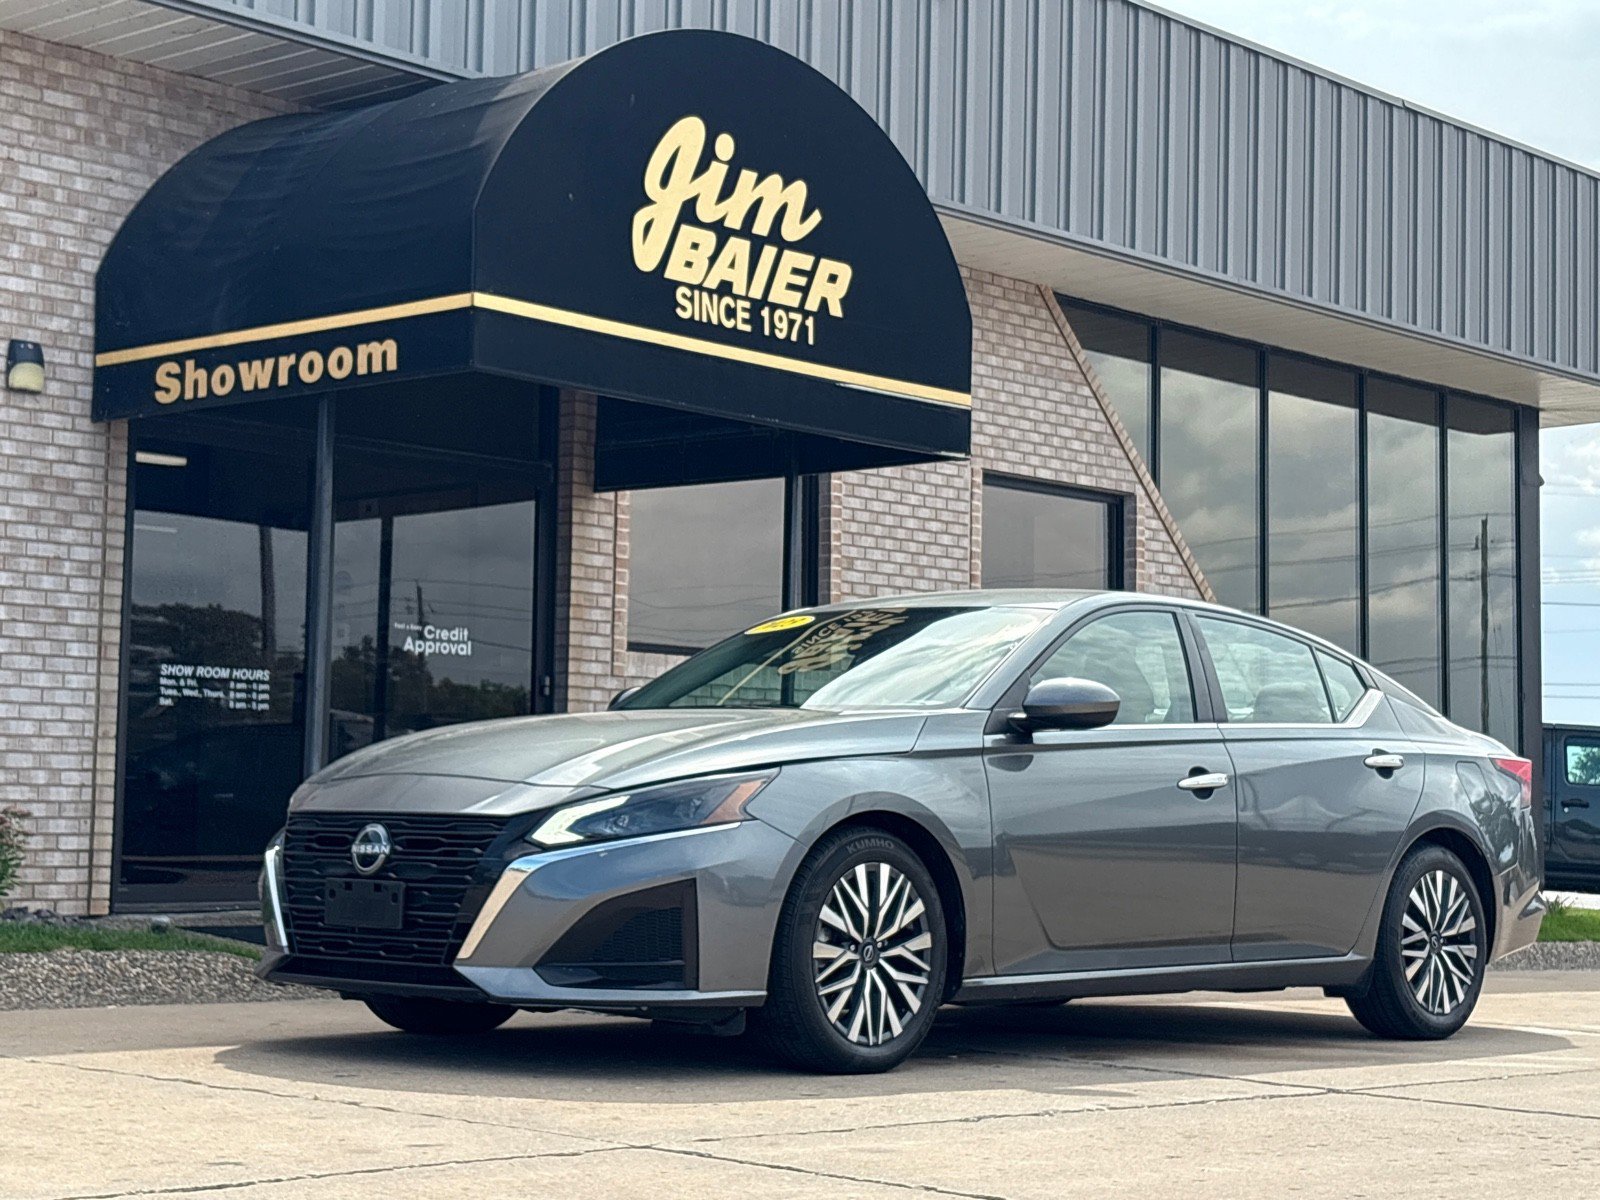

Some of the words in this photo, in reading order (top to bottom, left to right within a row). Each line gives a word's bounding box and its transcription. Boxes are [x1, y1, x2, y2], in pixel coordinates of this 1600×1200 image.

[632, 116, 822, 272] Jim
[663, 224, 852, 318] BAIER
[675, 286, 752, 332] SINCE
[761, 306, 814, 346] 1971
[154, 338, 398, 404] Showroom
[424, 625, 468, 642] Credit
[403, 636, 472, 656] Approval
[160, 663, 195, 677] SHOW
[196, 665, 230, 679] ROOM
[232, 668, 270, 681] HOURS
[351, 844, 390, 855] NISSAN
[846, 838, 894, 854] KUMHO
